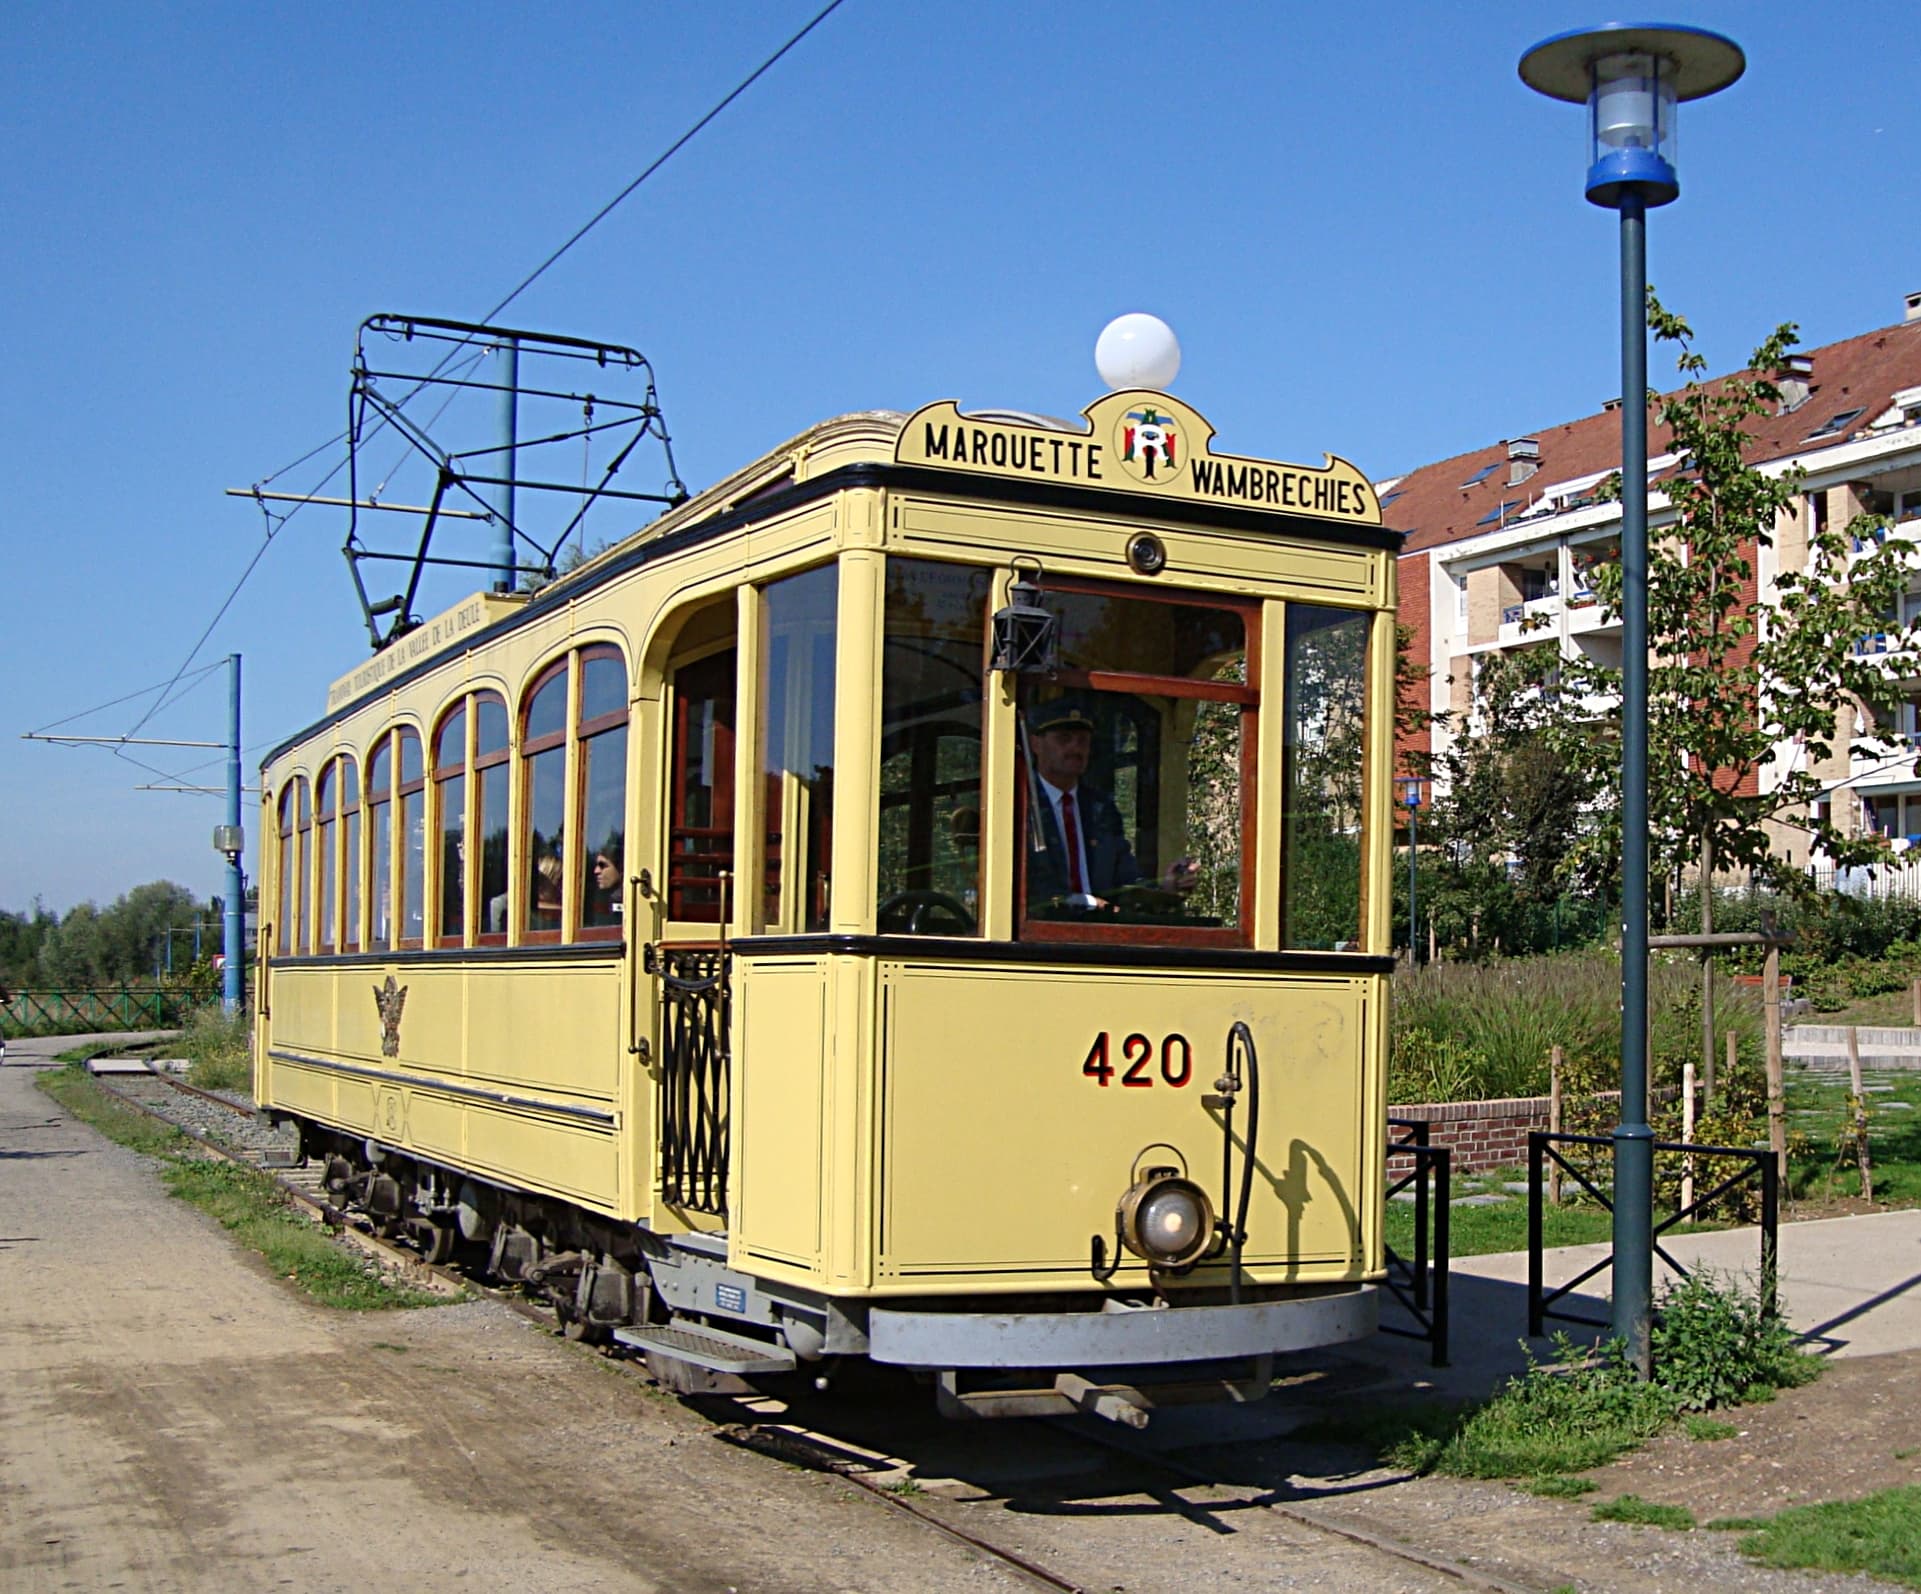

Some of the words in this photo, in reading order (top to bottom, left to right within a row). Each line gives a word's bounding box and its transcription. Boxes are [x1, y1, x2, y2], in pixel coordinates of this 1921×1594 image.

[925, 422, 1103, 479] MARQUETTE
[1191, 458, 1366, 516] WAMBRECHIES
[432, 624, 442, 646] DE
[444, 617, 455, 639] LA
[1082, 1031, 1192, 1088] 420
